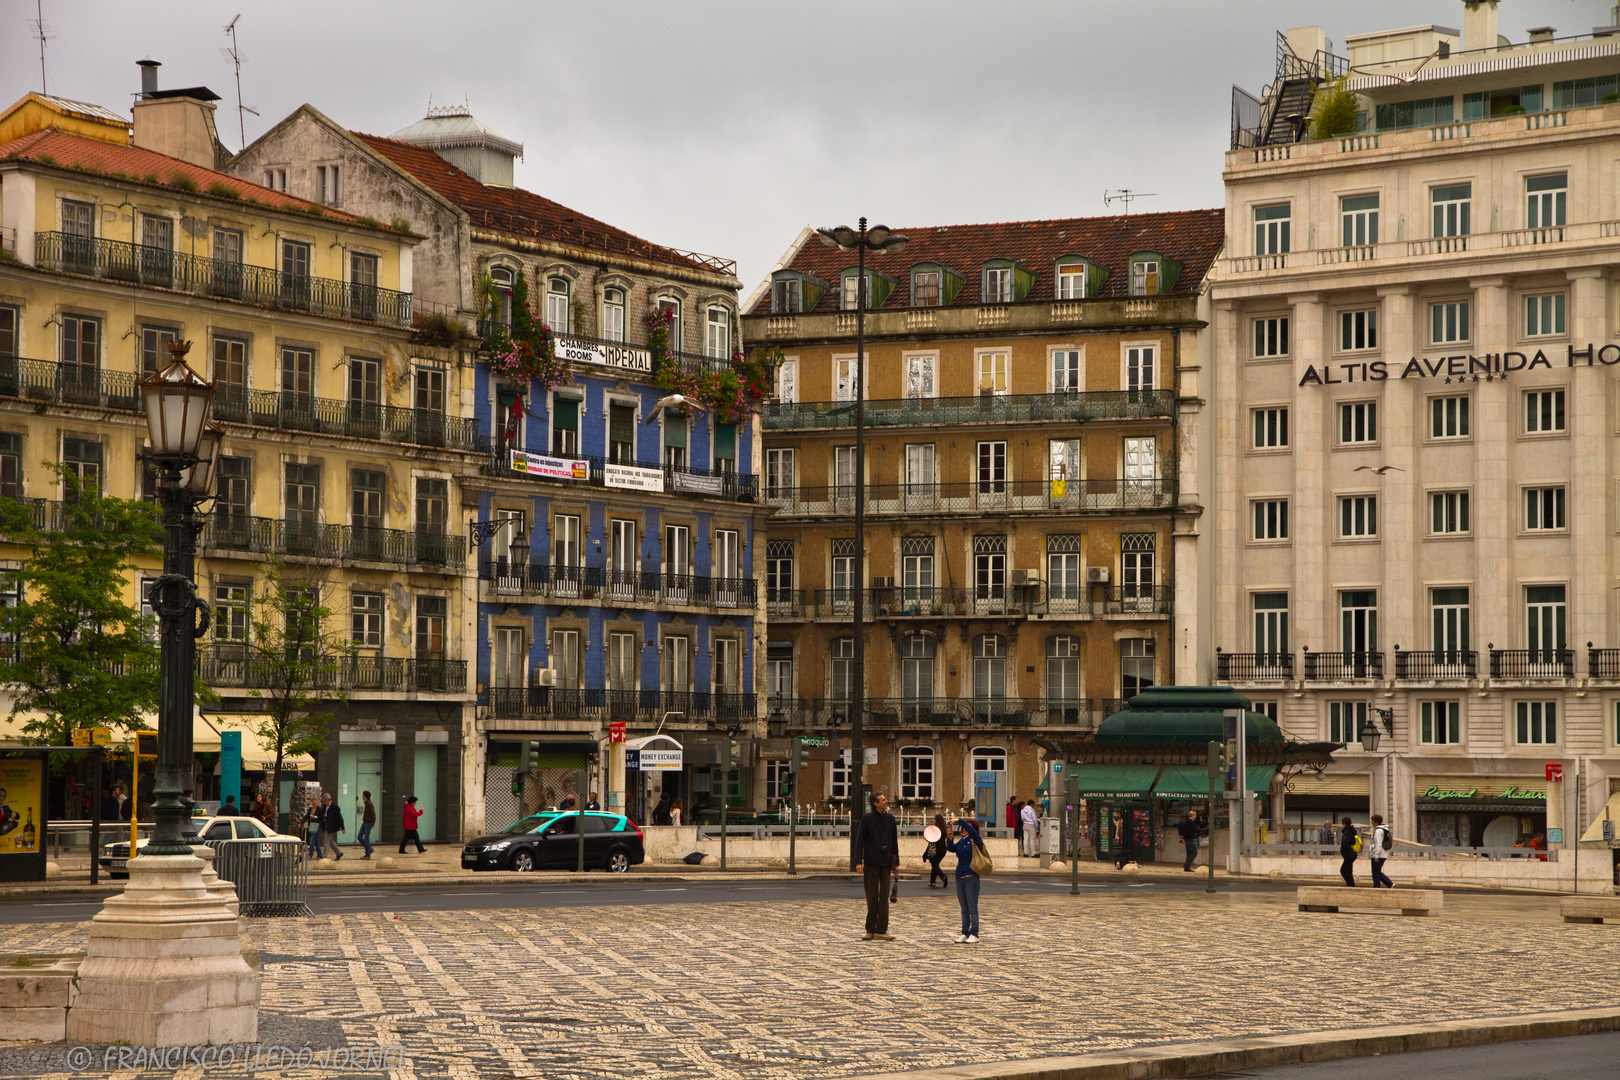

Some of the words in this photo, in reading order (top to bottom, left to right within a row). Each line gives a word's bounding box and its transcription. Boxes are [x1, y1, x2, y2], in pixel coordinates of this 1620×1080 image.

[560, 339, 598, 352] CHAMBRES
[566, 350, 592, 361] ROOMS
[605, 347, 650, 370] IMPERIAL
[1299, 361, 1388, 386] ALTIS
[1401, 349, 1552, 379] AVENIDA
[1568, 343, 1620, 367] HO
[527, 465, 542, 473] MUDAR
[261, 762, 298, 770] TABARIA
[1423, 785, 1477, 800] Regional
